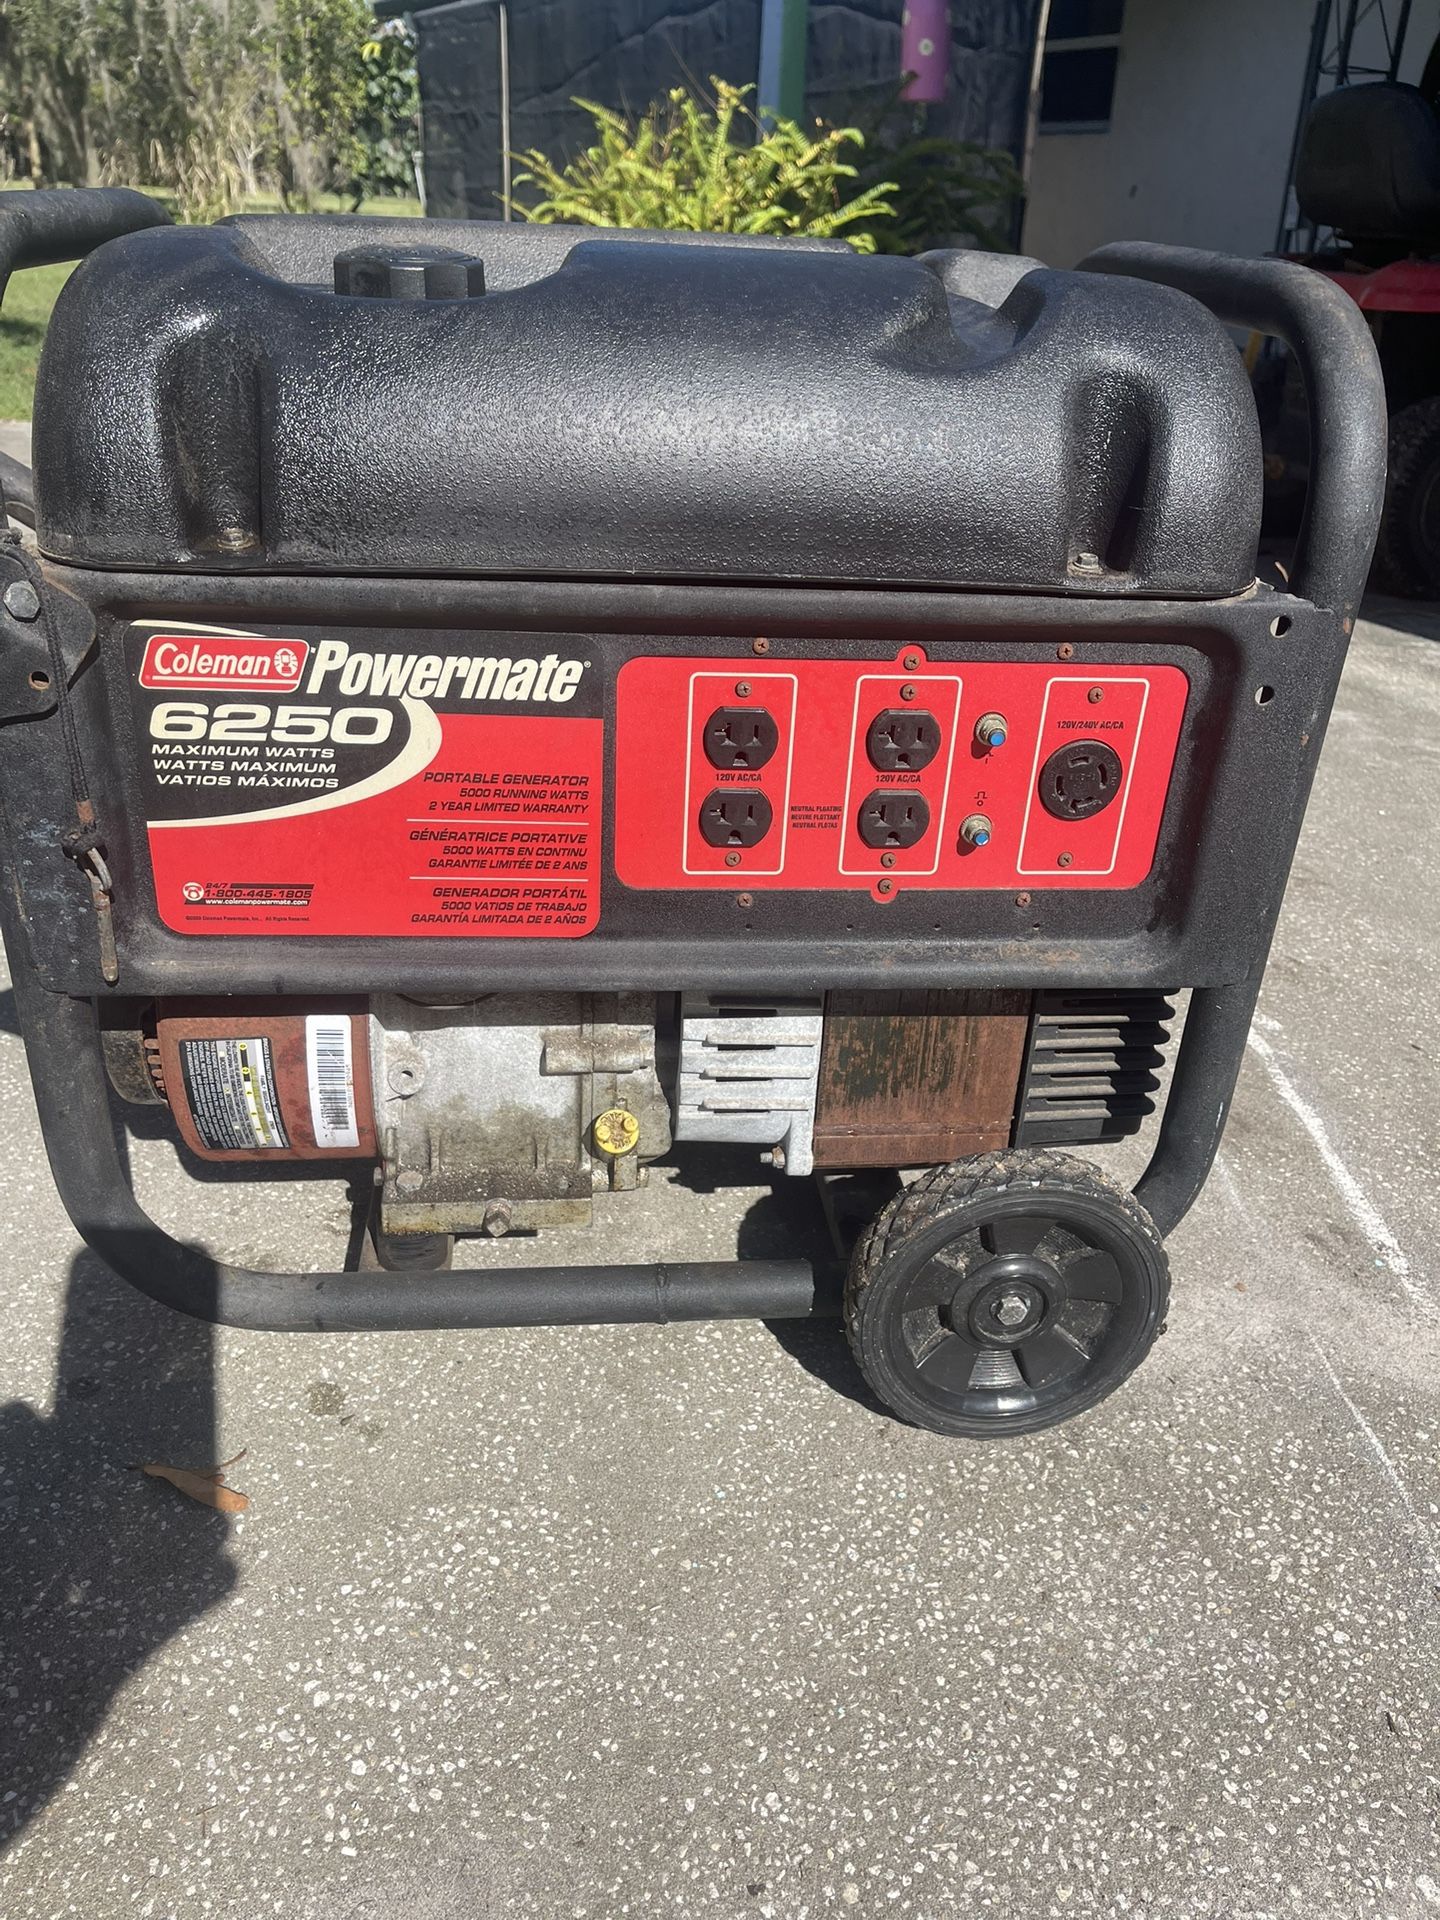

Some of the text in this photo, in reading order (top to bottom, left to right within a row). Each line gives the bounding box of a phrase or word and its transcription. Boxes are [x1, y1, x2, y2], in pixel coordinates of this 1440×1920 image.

[155, 643, 271, 675] Coleman
[150, 702, 393, 744] 6250
[152, 744, 334, 758] MAXIMUM WATTS
[153, 760, 336, 773] WATTS MAXIMUM
[156, 775, 338, 787] VATIOS MÁXIMOS
[424, 772, 589, 786] PORTABLE GENERATOR
[716, 773, 762, 782] 120V AC/CA
[897, 775, 921, 783] AC/CA
[460, 788, 589, 799] 5000 RUNNING WATTS
[429, 802, 589, 813] 2 YEAR LIMITED WARRANTY
[410, 828, 587, 843] GÉNÉRATRICE PORTATIVE
[443, 846, 473, 854] 5000
[477, 847, 514, 855] WATTS
[536, 848, 587, 857] CONTINU
[429, 859, 587, 870] GARANTIE LIMITÉE DE 2 ANS
[433, 887, 587, 898] GENERADOR PORTÁTIL
[442, 902, 586, 912] 5000 VATIOS DE TRABAJO
[412, 913, 586, 924] GARANTÍA LIMITADA DE 2 AÑOS
